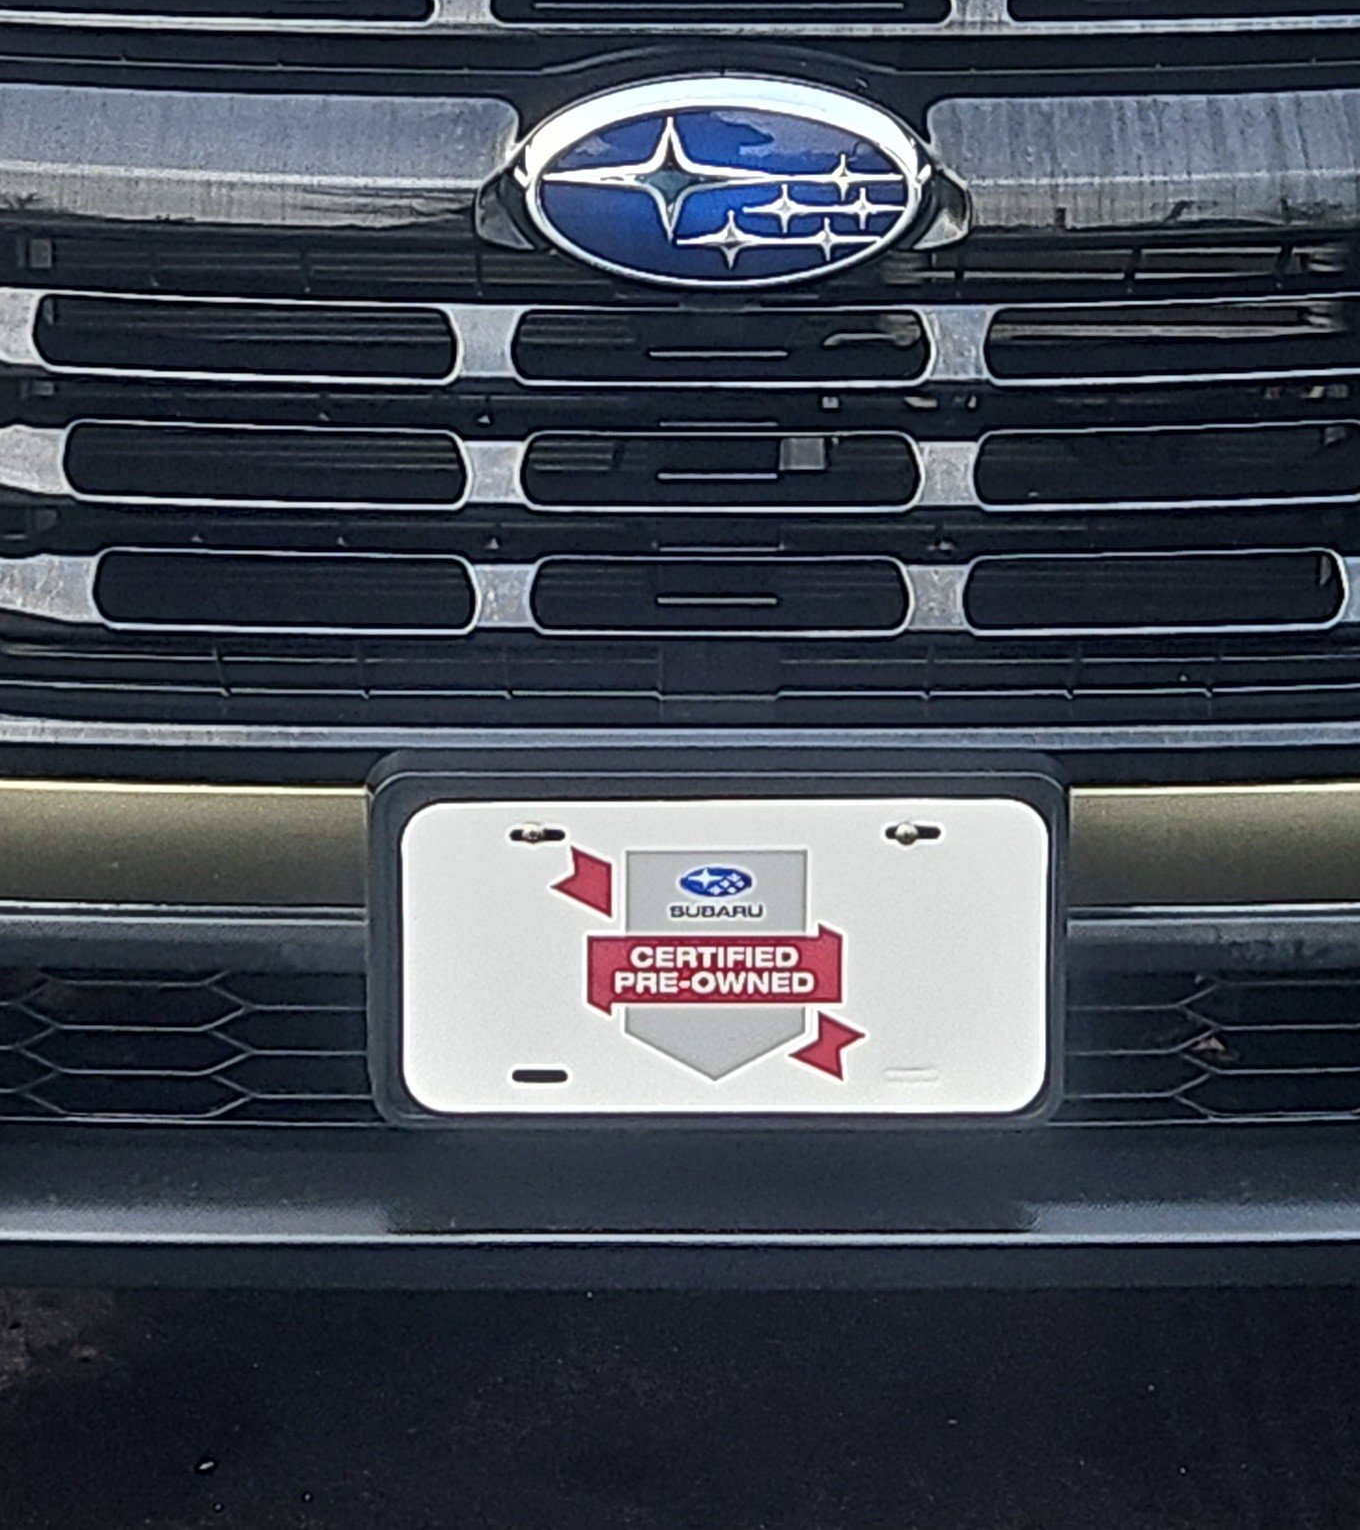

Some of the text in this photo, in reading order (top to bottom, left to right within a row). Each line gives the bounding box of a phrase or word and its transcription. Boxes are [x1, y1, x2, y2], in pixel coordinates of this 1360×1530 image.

[669, 905, 763, 918] SUBARU
[630, 946, 799, 968] CERTIFIED
[614, 971, 815, 994] PRE-OWNED
